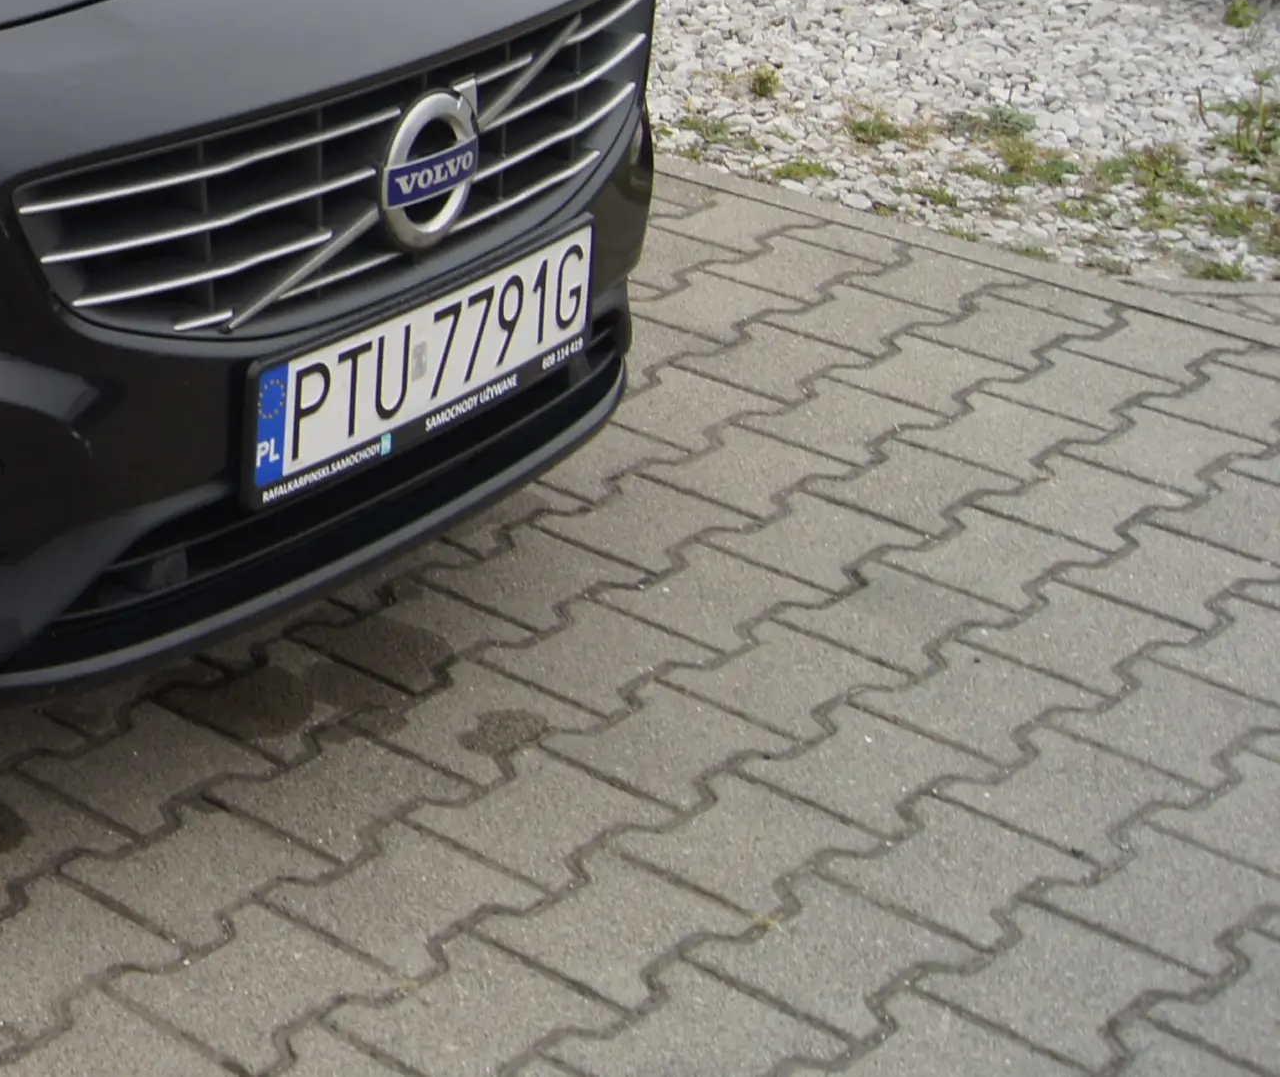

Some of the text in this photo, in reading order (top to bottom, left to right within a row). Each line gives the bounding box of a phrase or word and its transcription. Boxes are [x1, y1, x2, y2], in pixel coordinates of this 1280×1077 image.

[395, 151, 474, 195] VOLVO
[291, 243, 585, 462] PTU 7791G
[424, 393, 479, 432] SAMOCHODY
[255, 437, 280, 467] PL
